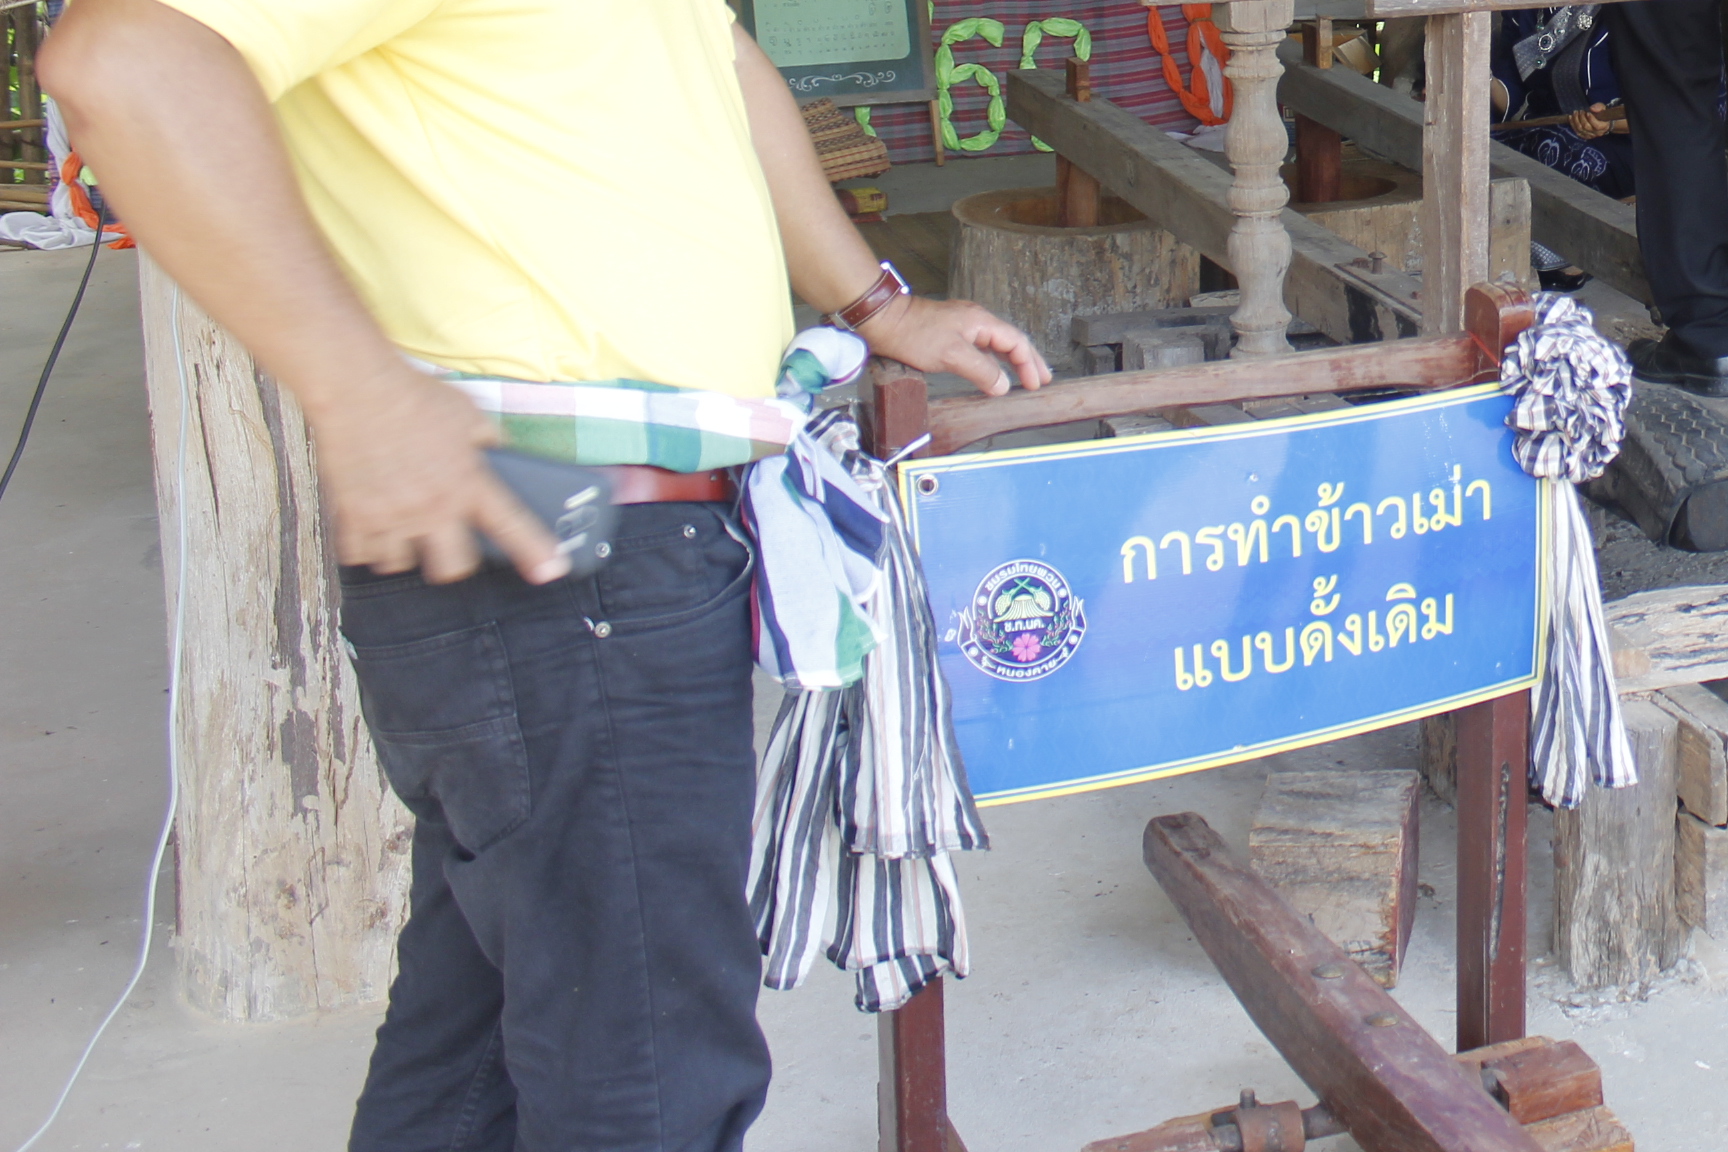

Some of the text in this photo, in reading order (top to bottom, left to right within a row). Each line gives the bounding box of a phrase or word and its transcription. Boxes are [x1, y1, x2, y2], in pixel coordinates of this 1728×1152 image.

[1120, 463, 1494, 585] การทำข้าวเม่า
[984, 562, 1062, 593] ชมรมไทยพวน
[996, 658, 1057, 678] หนองคาย
[1172, 574, 1456, 692] แบบดั้งเดิม
